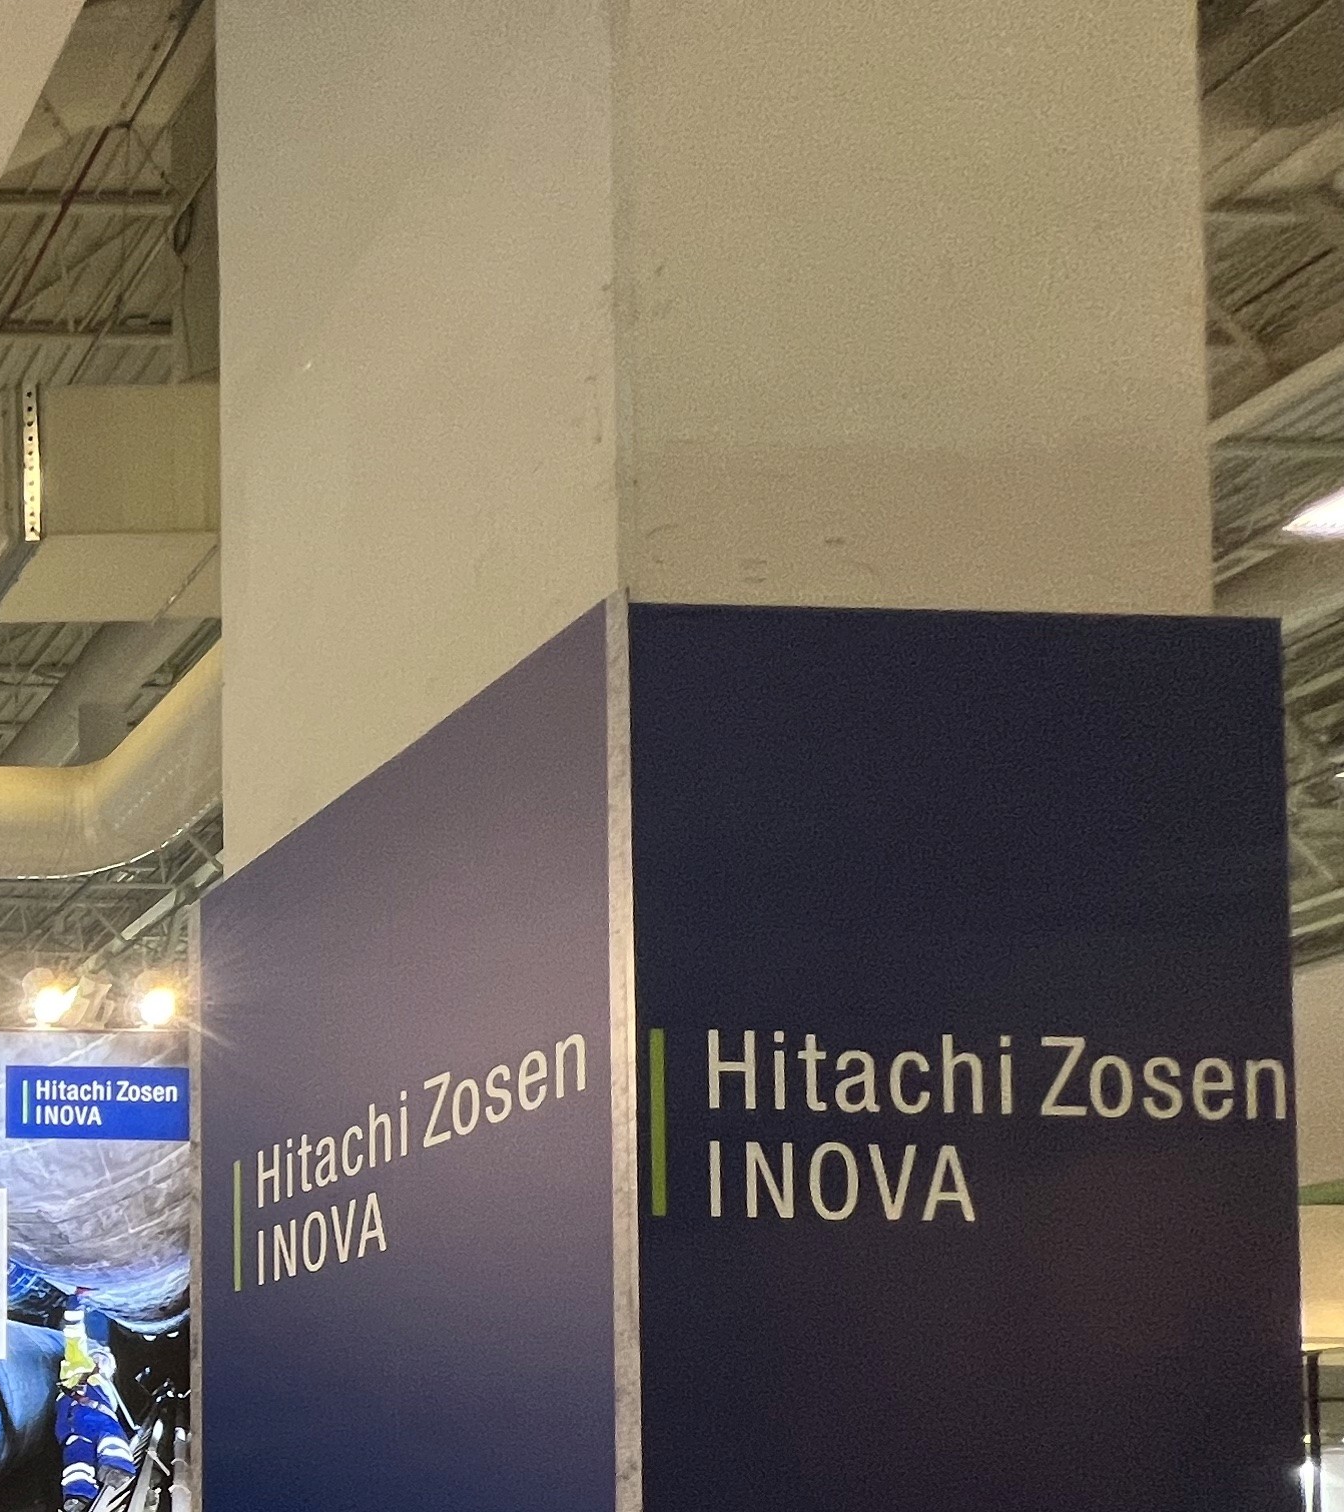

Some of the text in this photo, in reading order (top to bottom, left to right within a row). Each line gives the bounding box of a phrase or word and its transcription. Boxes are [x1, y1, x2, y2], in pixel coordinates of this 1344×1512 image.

[35, 1079, 178, 1102] Hitachi Zosen
[35, 1105, 102, 1126] INOVA
[708, 1029, 1288, 1122] Hitachi Zosen
[256, 1033, 586, 1209] Hitachi Zosen
[710, 1140, 976, 1223] INOVA
[256, 1192, 387, 1286] INOVA
